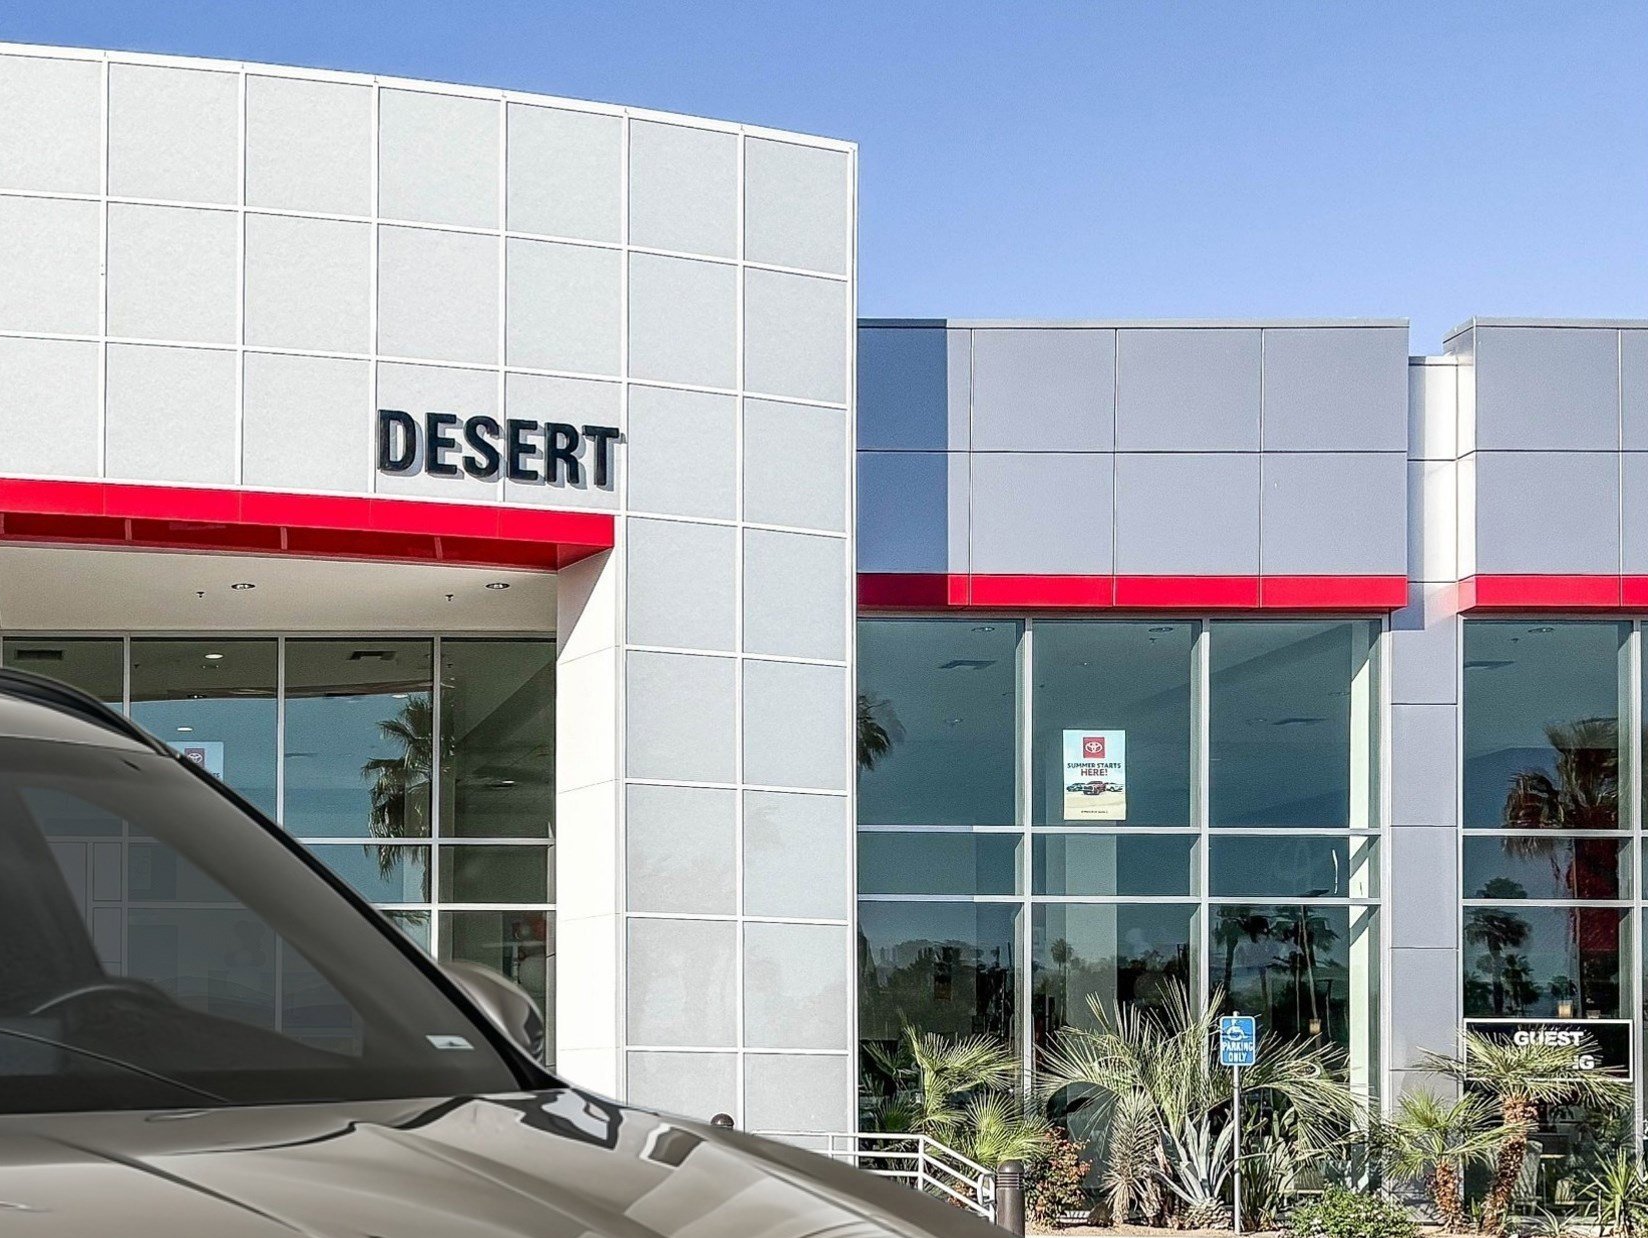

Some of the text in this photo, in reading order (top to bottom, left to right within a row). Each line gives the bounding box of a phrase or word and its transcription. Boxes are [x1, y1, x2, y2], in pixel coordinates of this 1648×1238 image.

[377, 409, 620, 486] DESERT
[1513, 1031, 1584, 1047] GUEST
[1222, 1041, 1254, 1052] PARKING
[1228, 1052, 1248, 1063] ONLY
